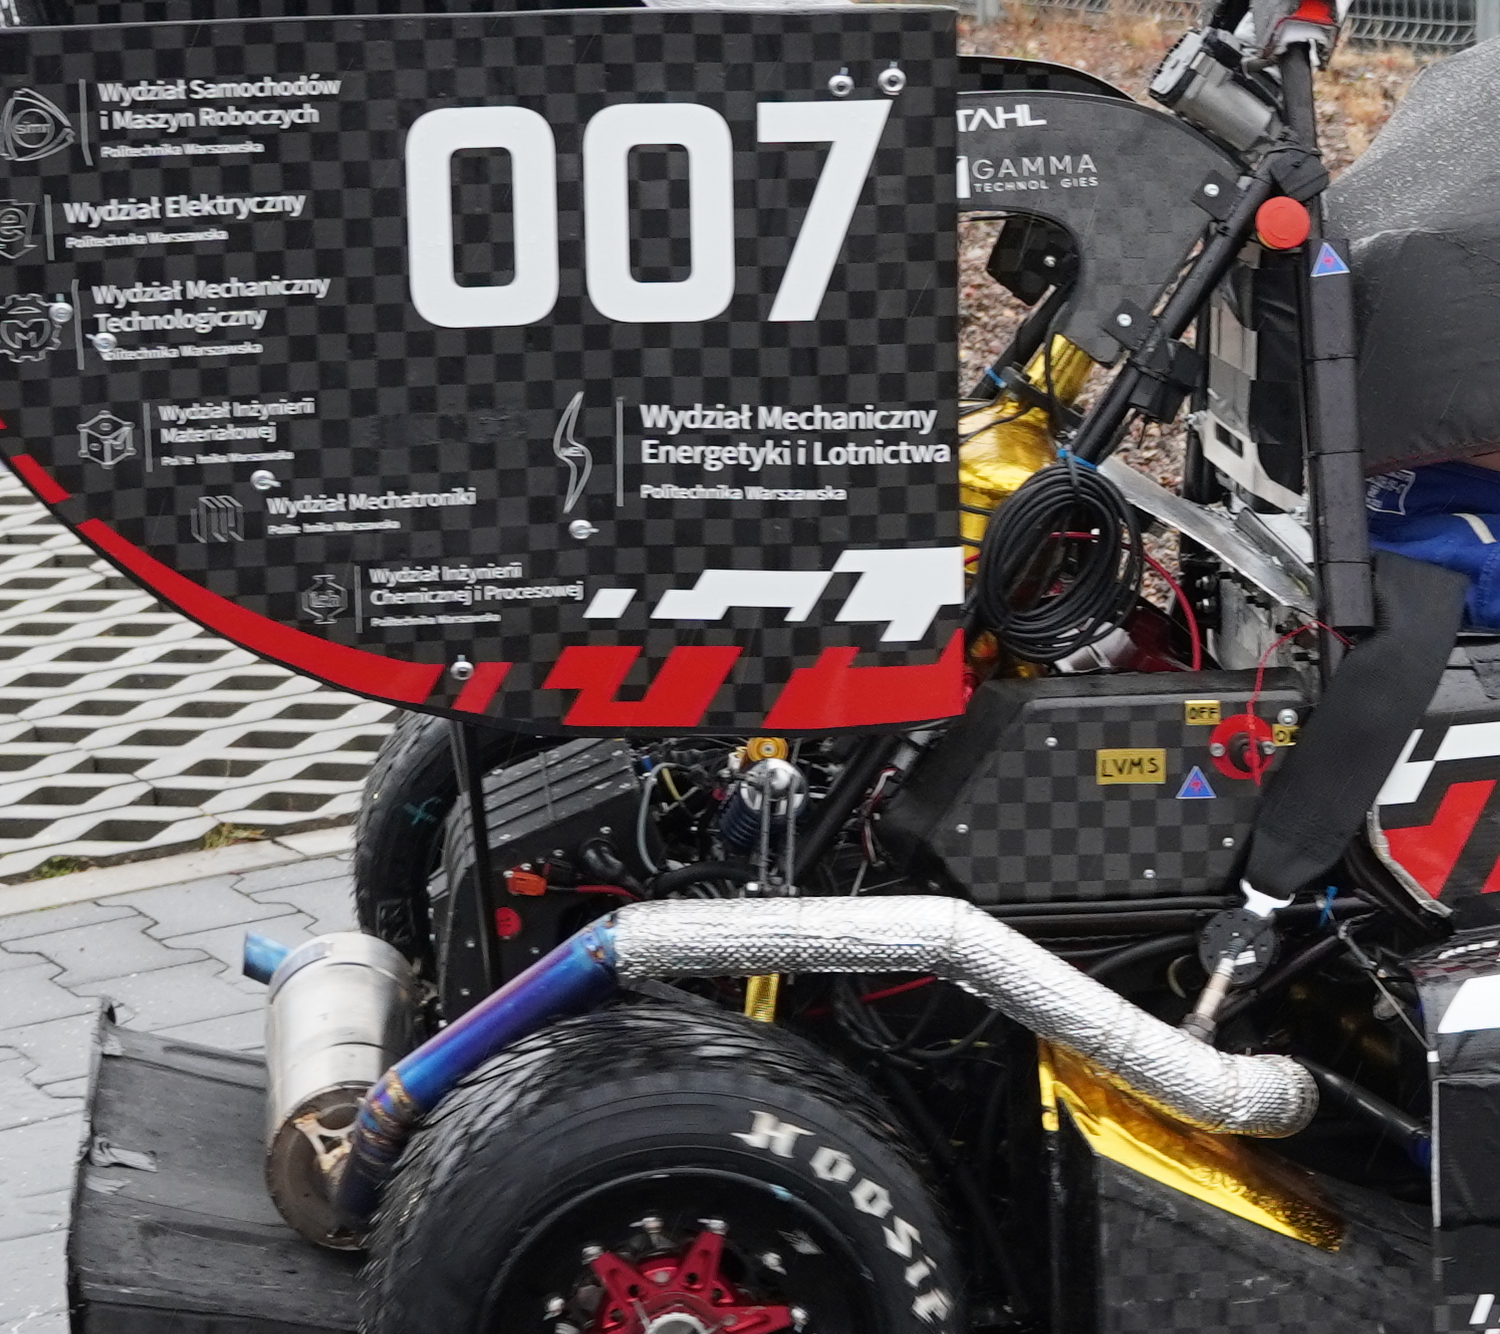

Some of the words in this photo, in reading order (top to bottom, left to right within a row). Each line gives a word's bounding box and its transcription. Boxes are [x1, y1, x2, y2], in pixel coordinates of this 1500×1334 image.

[98, 80, 186, 106] Wydział
[189, 74, 341, 100] Samochodów
[113, 110, 195, 133] Maszyn
[199, 103, 319, 130] Roboczych
[972, 154, 1097, 179] GAMMA
[973, 177, 1099, 192] TECHNOLGIES
[62, 198, 161, 228] Wydział
[165, 194, 306, 219] Elektryczny
[405, 99, 892, 328] 007
[91, 281, 183, 308] Wydział
[186, 275, 330, 300] Mechaniczny
[94, 307, 267, 332] Technologiczny
[158, 402, 231, 424] Wydział
[640, 404, 752, 435] Wydział
[758, 404, 937, 434] Mechaniczny
[160, 422, 276, 444] Materiałowej
[641, 440, 791, 471] Energetyki
[797, 440, 806, 465] i
[813, 440, 951, 465] Lotnictwa
[265, 493, 346, 519] Wydział
[348, 487, 477, 511] Mechatroniki
[640, 484, 743, 500] Politechnika
[745, 485, 847, 501] Warszawska
[483, 581, 584, 601] Procesowej
[1188, 707, 1219, 720] OFF
[1101, 757, 1159, 777] LVMS
